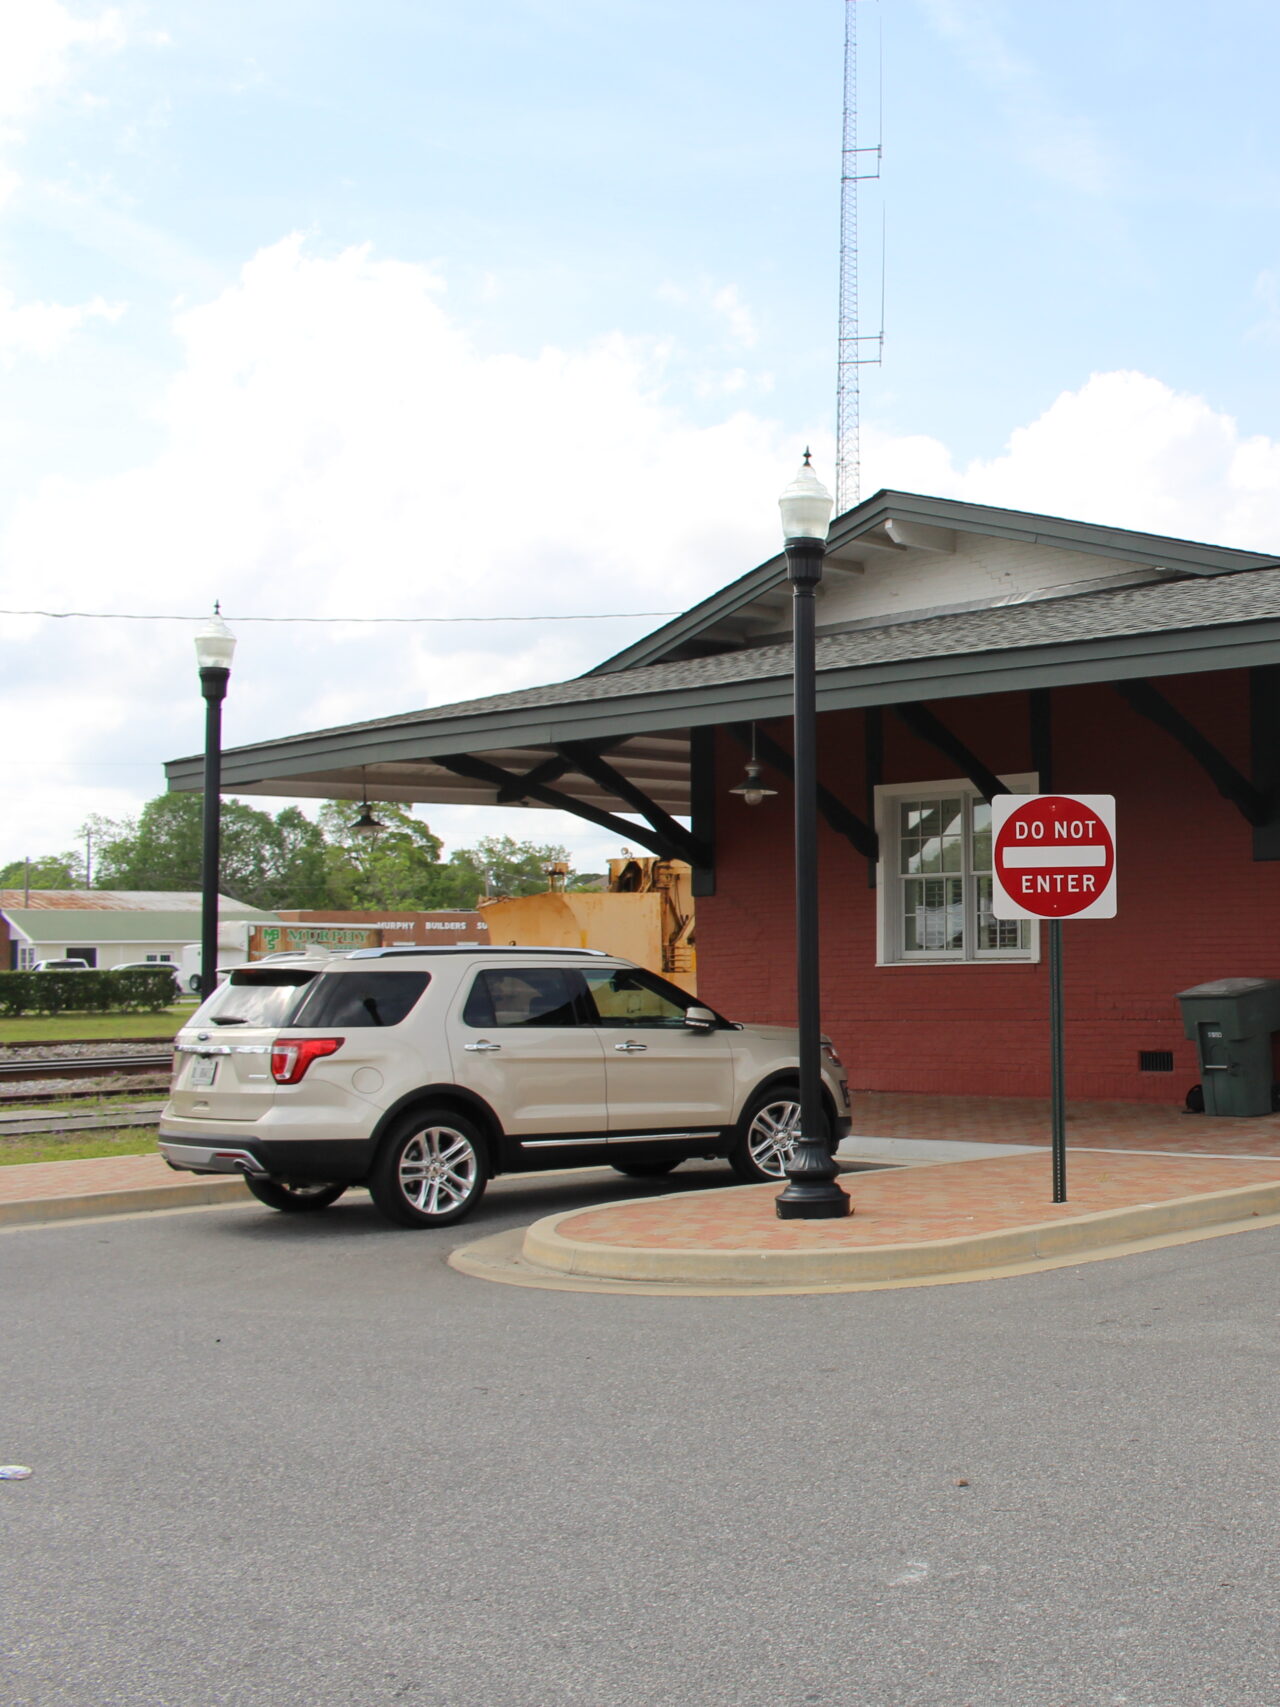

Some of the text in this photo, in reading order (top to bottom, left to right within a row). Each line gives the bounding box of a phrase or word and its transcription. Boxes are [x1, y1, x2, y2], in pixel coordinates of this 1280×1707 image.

[1015, 820, 1096, 840] DO NOT
[1021, 874, 1096, 894] ENTER
[377, 921, 416, 930] MURPHY
[425, 921, 467, 930] BUILDERS
[287, 928, 370, 942] MURPHY
